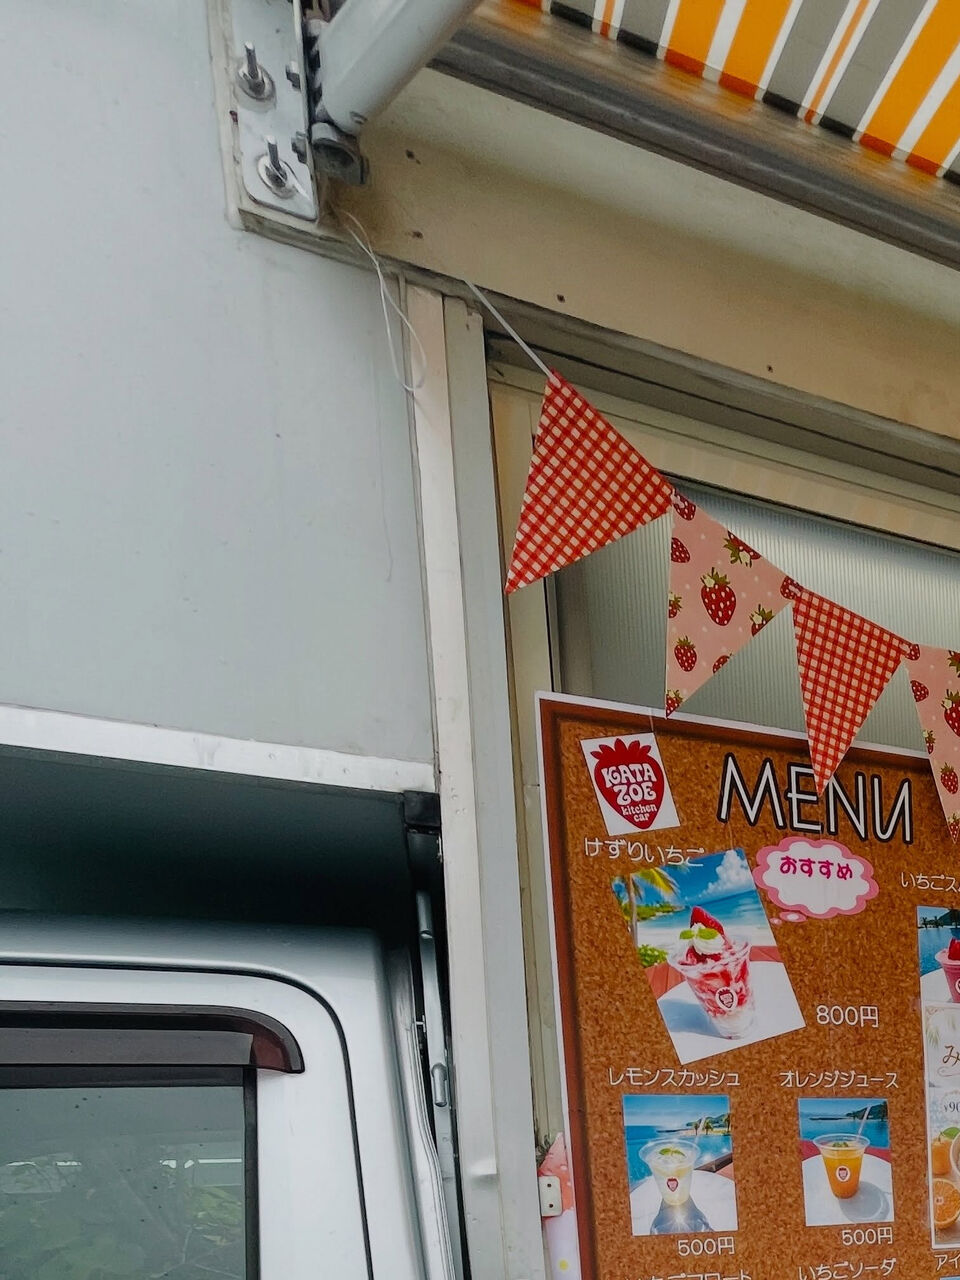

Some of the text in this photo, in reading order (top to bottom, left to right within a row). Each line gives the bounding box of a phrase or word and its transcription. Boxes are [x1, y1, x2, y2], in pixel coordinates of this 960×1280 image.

[601, 763, 657, 788] KATA
[613, 781, 657, 805] ZOE
[717, 753, 913, 844] MENU
[621, 803, 657, 816] kitchen
[633, 812, 650, 822] car
[584, 837, 705, 866] けずりいちご
[779, 855, 853, 880] おすすめ
[815, 1005, 880, 1028] 800円
[608, 1067, 741, 1088] レモンスカッシュ
[779, 1069, 899, 1089] オレンジジュース
[677, 1236, 736, 1256] 500円
[841, 1227, 894, 1247] 500円
